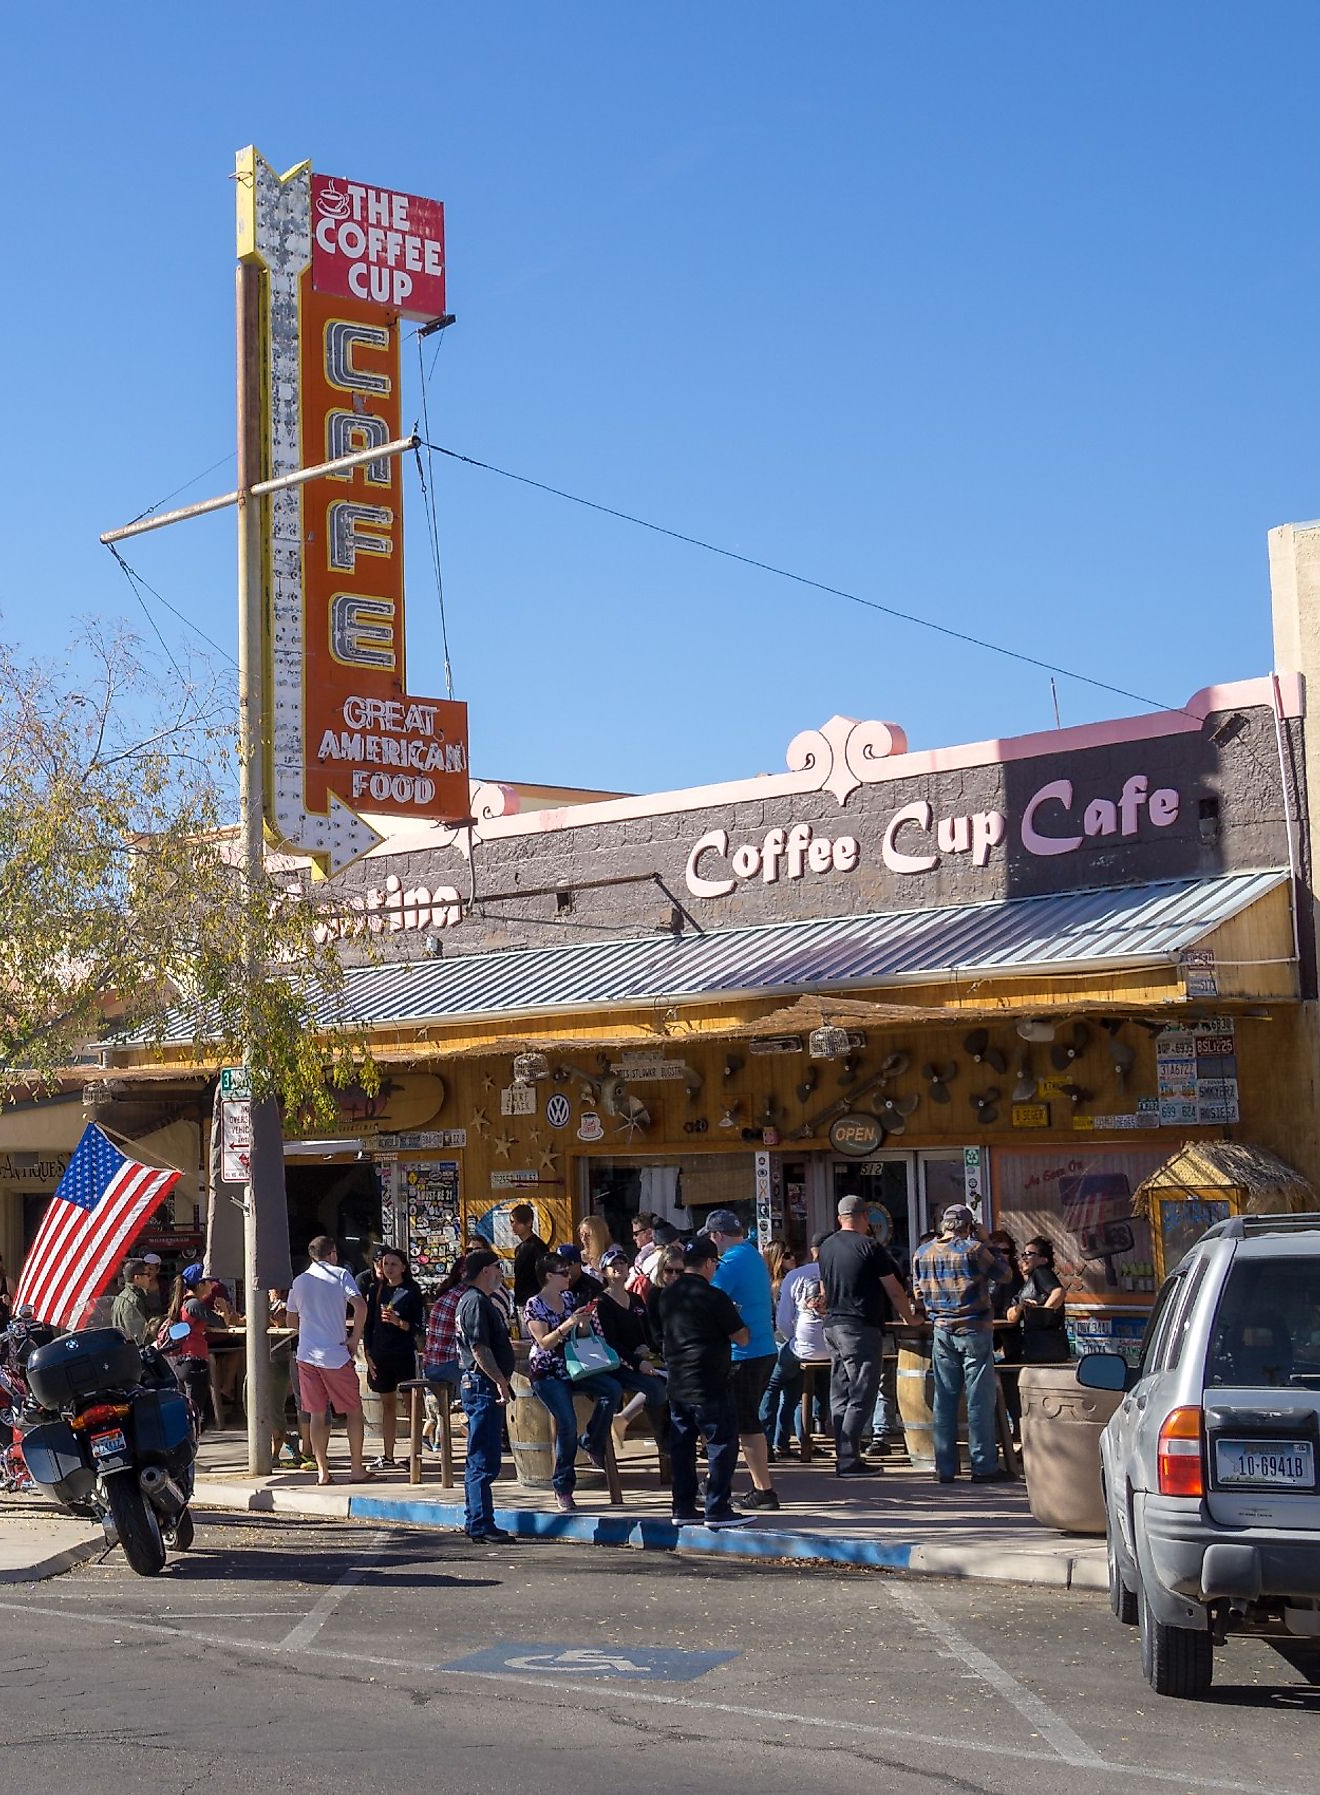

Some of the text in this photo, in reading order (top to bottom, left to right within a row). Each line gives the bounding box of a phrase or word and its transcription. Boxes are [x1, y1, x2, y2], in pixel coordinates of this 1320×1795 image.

[348, 184, 410, 232] THE
[316, 217, 442, 277] COFFEE
[348, 262, 413, 306] CUP
[323, 318, 396, 672] CAFE
[343, 696, 439, 736] GREAT
[318, 729, 467, 774] AMERICAN
[352, 769, 436, 804] FOOD
[685, 774, 1179, 899] Coffee Cup Cafe
[835, 1126, 875, 1142] OPEN
[861, 1163, 882, 1176] 512
